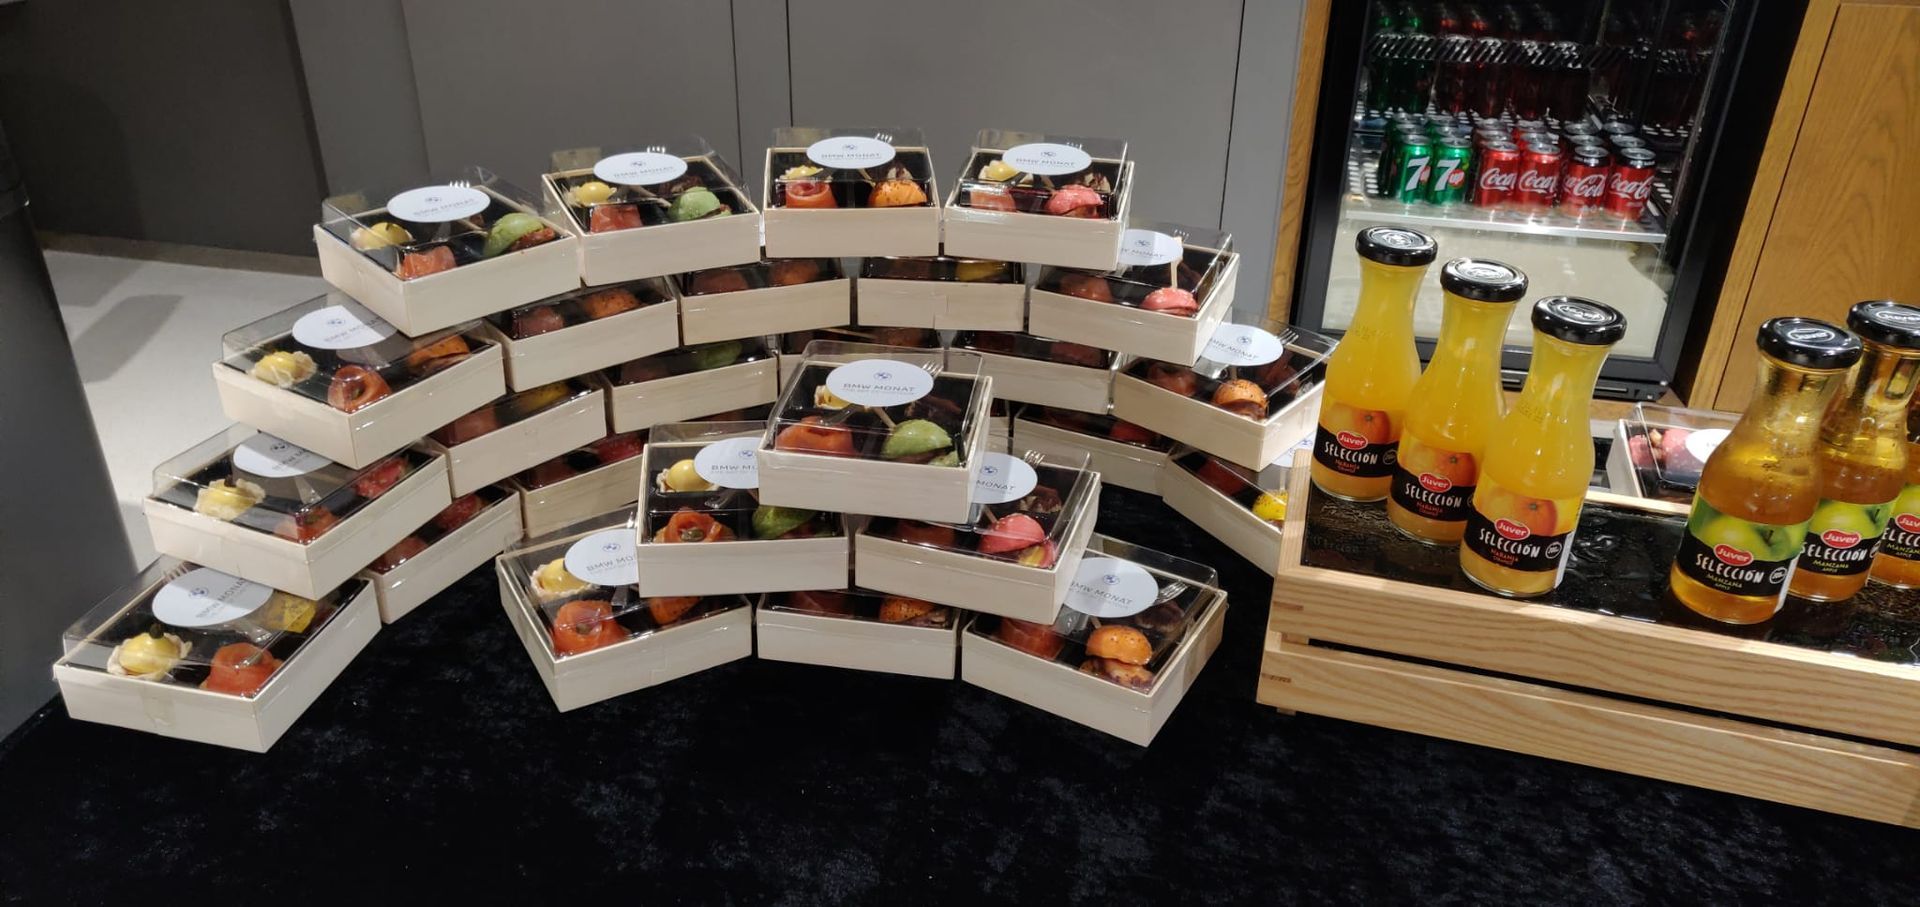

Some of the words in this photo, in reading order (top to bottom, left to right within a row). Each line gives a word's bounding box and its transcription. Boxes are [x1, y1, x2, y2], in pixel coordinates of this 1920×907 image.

[874, 384, 916, 392] MONAT
[1340, 434, 1366, 447] Juver
[1324, 441, 1378, 465] SELECCIÓN
[976, 479, 1016, 491] MONAT
[1422, 475, 1449, 489] Juver
[1405, 482, 1462, 508] SELECCIÓN
[1497, 522, 1527, 537] Juver
[1881, 527, 1920, 547] ELECC
[1479, 528, 1541, 558] SELECCIÓN
[1825, 533, 1858, 544] Juver
[1717, 548, 1750, 562] Juver
[1887, 543, 1920, 554] MANZAN
[586, 560, 613, 572] BMW
[615, 555, 634, 564] MO
[1695, 553, 1765, 584] SELECCIÓN
[1812, 559, 1850, 569] MANZANA
[1705, 573, 1743, 589] MANZANA
[1070, 581, 1093, 593] MW
[1094, 588, 1133, 605] MONAT
